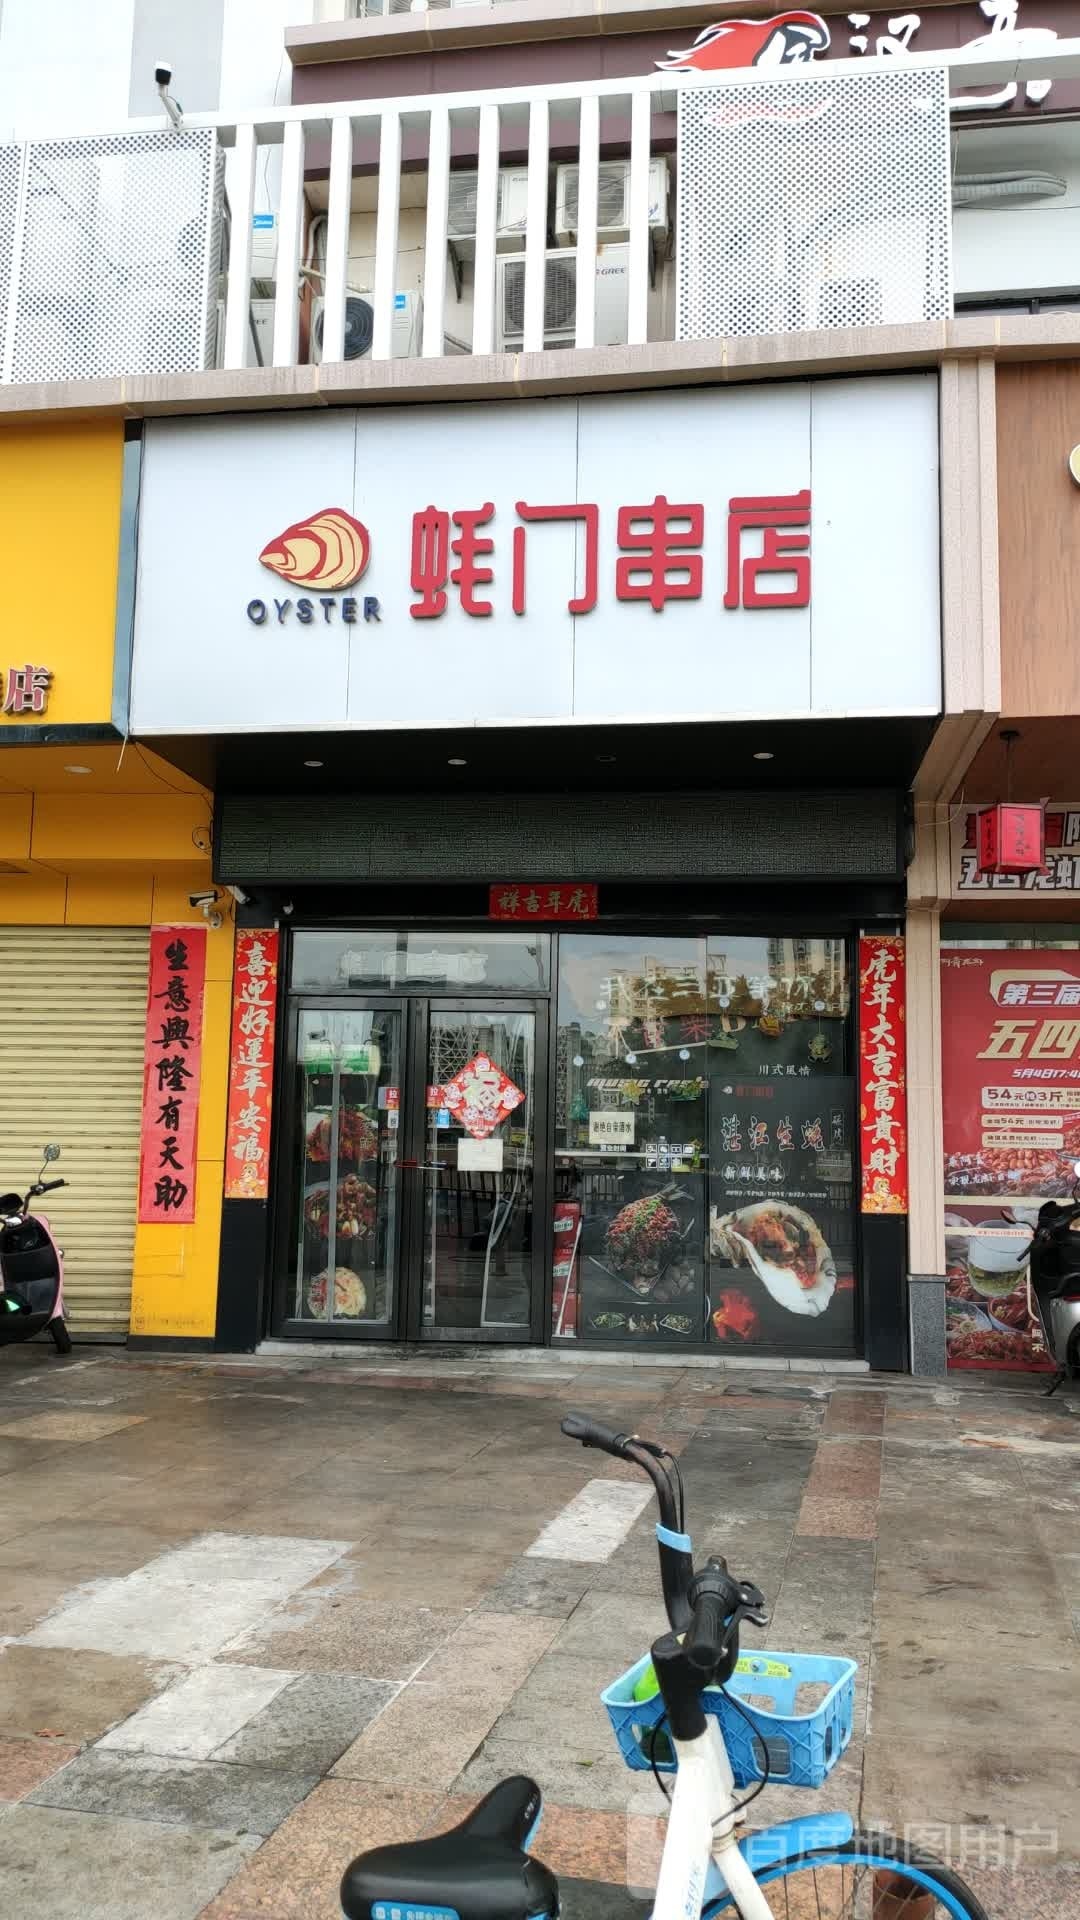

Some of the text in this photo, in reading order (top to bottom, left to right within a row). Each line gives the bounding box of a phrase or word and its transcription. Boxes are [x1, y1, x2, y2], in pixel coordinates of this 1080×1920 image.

[246, 596, 382, 624] OYSTER
[409, 489, 812, 618] 蚝门串店
[1000, 984, 1080, 1005] 第三届
[152, 938, 195, 1212] 生意興隆有天助
[863, 948, 901, 1177] 虎年大吉富貴財
